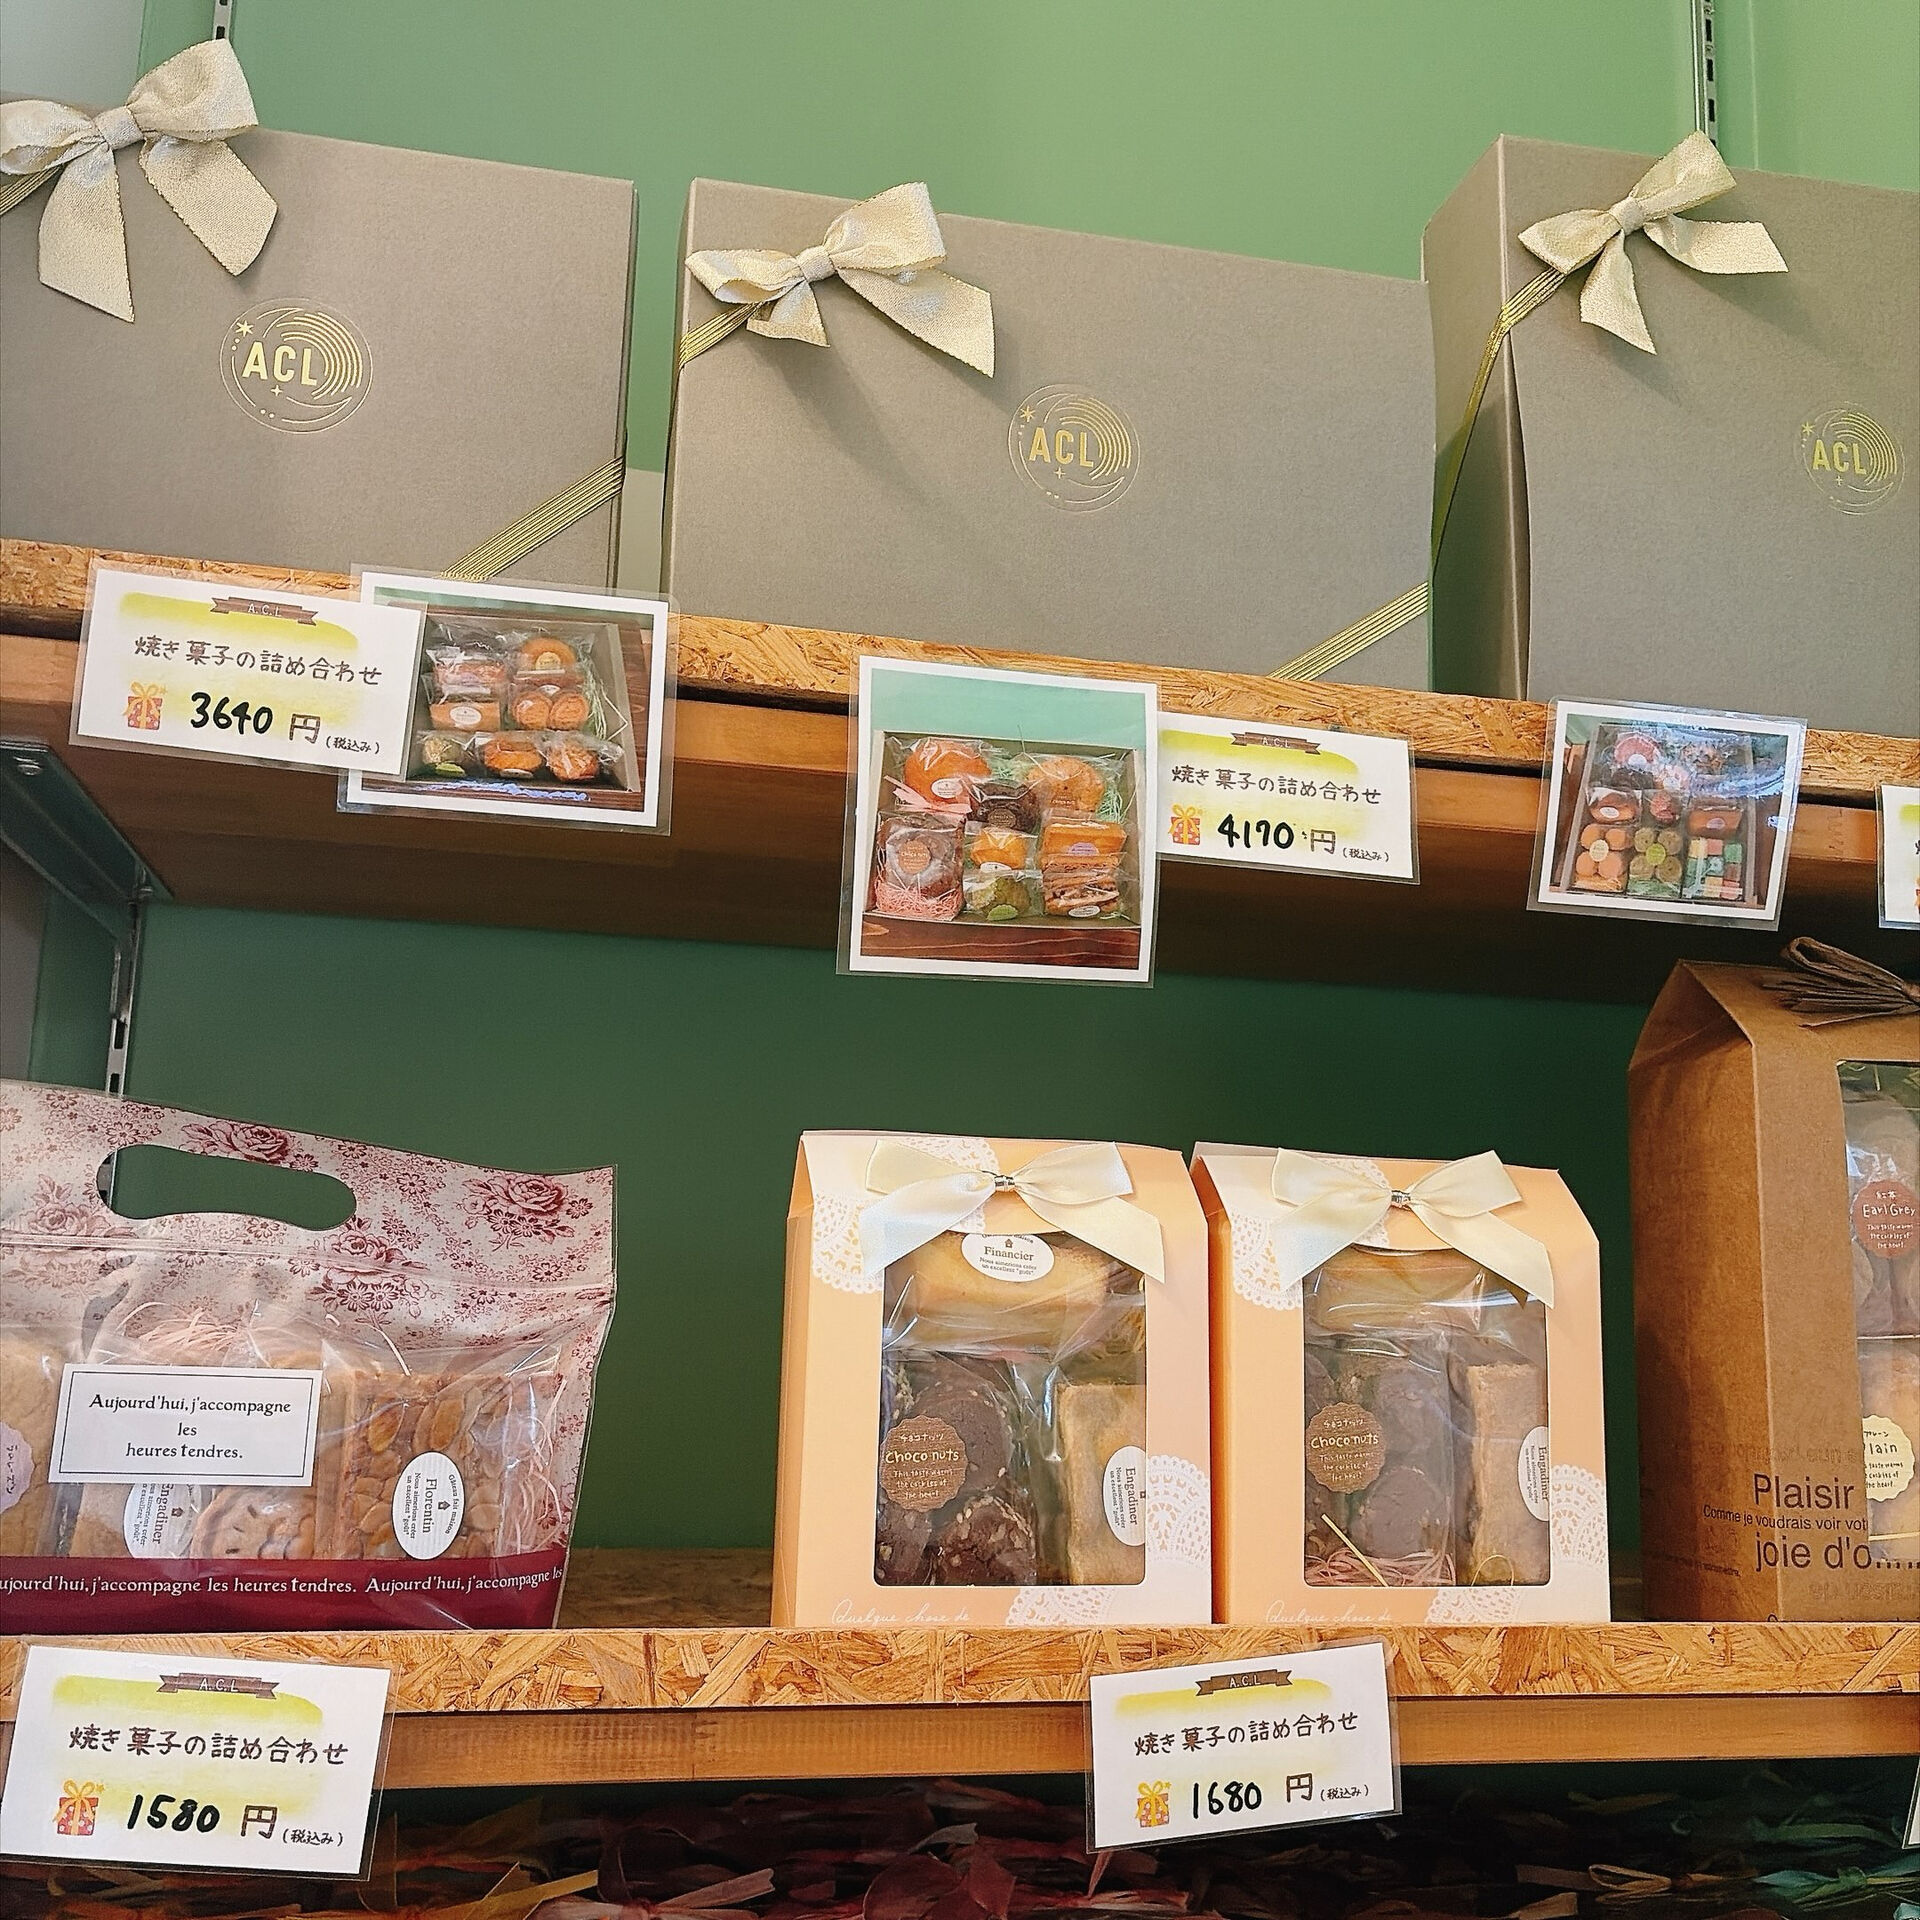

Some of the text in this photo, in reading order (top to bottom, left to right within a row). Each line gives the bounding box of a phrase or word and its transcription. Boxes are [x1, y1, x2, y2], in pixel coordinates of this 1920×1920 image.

[242, 341, 317, 386] ACL
[1028, 427, 1094, 467] ACL
[1812, 439, 1866, 475] ACL
[190, 691, 273, 735] 3640
[289, 712, 321, 744] 円
[1217, 814, 1294, 850] 4170
[1310, 828, 1336, 854] 円
[1863, 1203, 1916, 1218] Earl Grey
[984, 1246, 1034, 1261] Financier
[89, 1394, 292, 1416] Aujourd'hui, j'accompagne
[177, 1422, 197, 1436] les
[1353, 1433, 1379, 1445] nuts
[125, 1443, 243, 1459] heures tendres.
[932, 1448, 959, 1461] nuts
[1863, 1443, 1898, 1455] lain
[422, 1478, 438, 1534] Florentin
[1124, 1467, 1139, 1526] Engadiner
[1753, 1473, 1854, 1510] Plaisir
[1703, 1504, 1741, 1523] Comme
[1743, 1512, 1753, 1527] je
[1755, 1514, 1811, 1530] voudrais
[1815, 1517, 1841, 1530] voir
[1755, 1532, 1811, 1572] joie
[0, 1576, 89, 1595] ujourd'hui,
[90, 1576, 201, 1596] j'accompagne
[207, 1577, 229, 1592] les
[234, 1577, 287, 1592] heures
[291, 1577, 357, 1593] tendres.
[364, 1576, 465, 1596] Aujourd'hui,
[465, 1571, 550, 1594] j'accompagne
[1192, 1781, 1262, 1820] 1680
[1285, 1772, 1313, 1803] 円
[127, 1793, 221, 1834] 1580
[240, 1804, 278, 1839] 円
